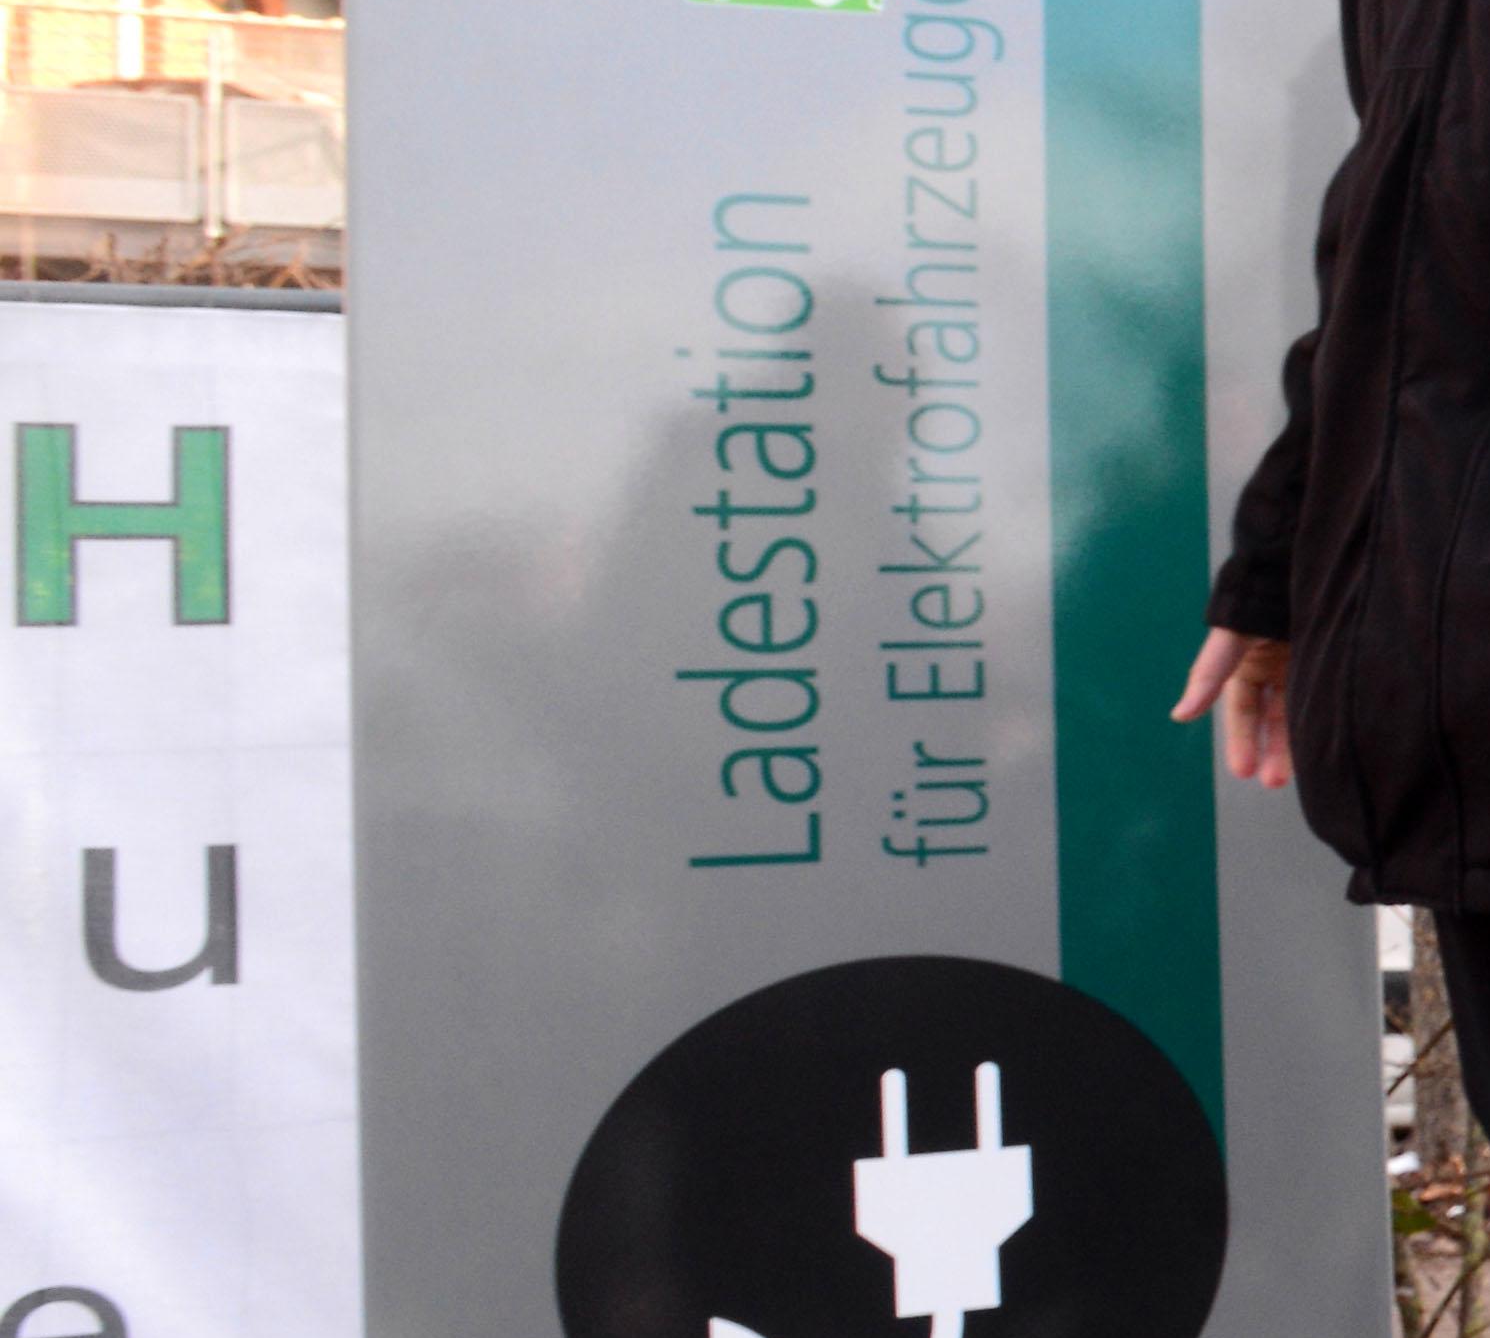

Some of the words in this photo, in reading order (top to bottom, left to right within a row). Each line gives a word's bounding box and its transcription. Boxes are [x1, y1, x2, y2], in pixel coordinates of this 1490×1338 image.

[15, 422, 232, 627] H
[675, 192, 822, 869] Ladestation
[881, 739, 990, 867] für
[80, 843, 242, 992] u
